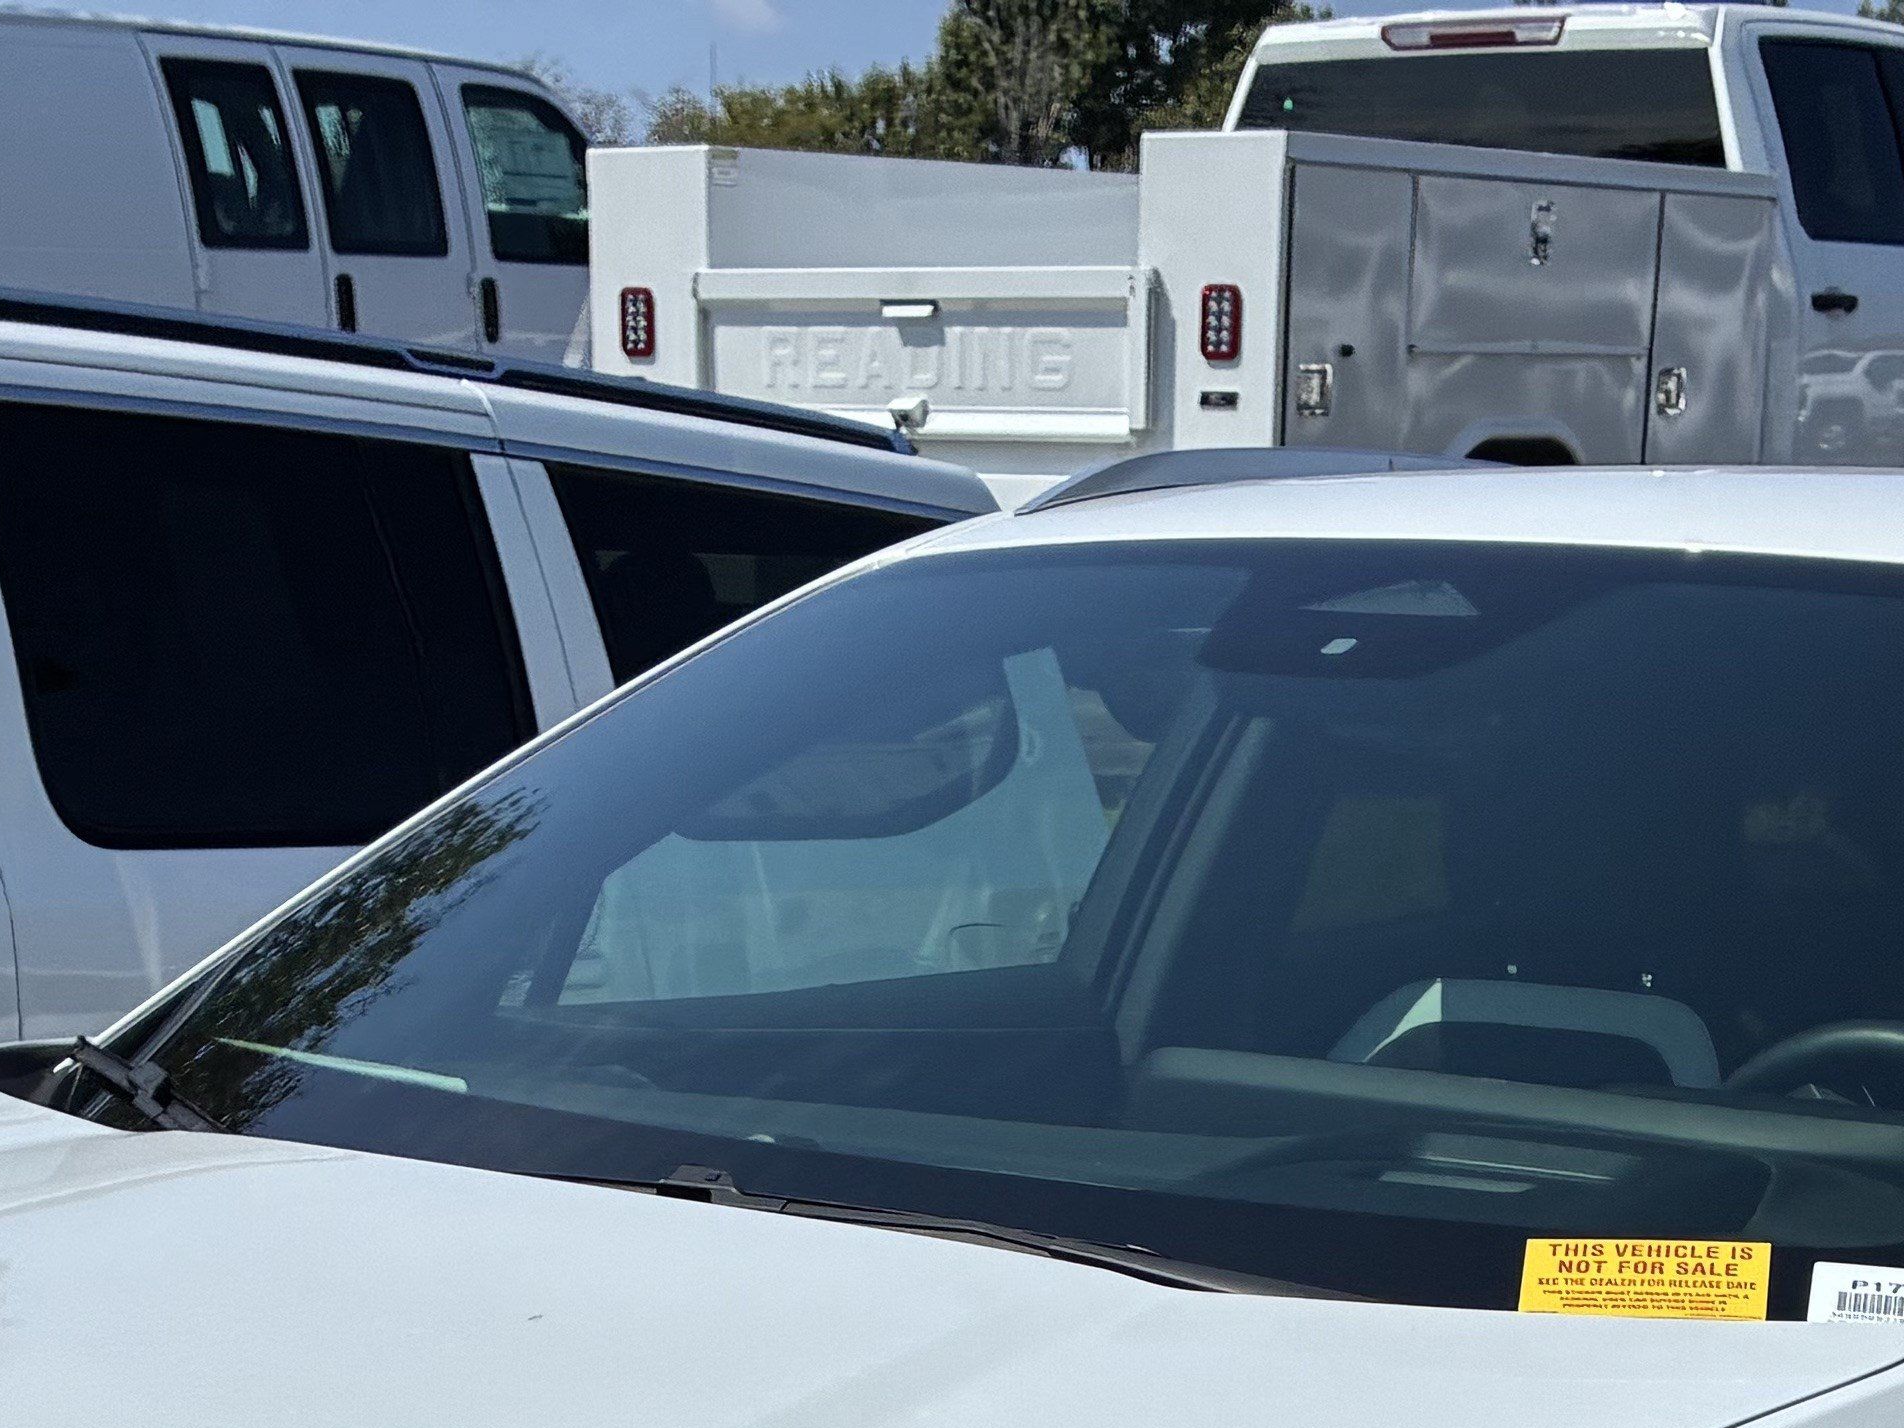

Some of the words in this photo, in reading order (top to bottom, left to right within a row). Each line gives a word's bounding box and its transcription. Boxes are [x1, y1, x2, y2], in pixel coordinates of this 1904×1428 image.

[762, 325, 1072, 392] READING
[1549, 1243, 1605, 1257] THIS
[1615, 1244, 1720, 1259] VEHICLE
[1731, 1246, 1753, 1260] IS
[1558, 1260, 1608, 1274] NOT
[1618, 1261, 1664, 1275] FOR
[1676, 1261, 1739, 1277] SALE
[1564, 1278, 1585, 1286] THE
[1590, 1278, 1637, 1287] DEALER
[1640, 1278, 1665, 1287] FOR
[1669, 1280, 1722, 1289] RELEASE
[1727, 1281, 1757, 1290] DATE
